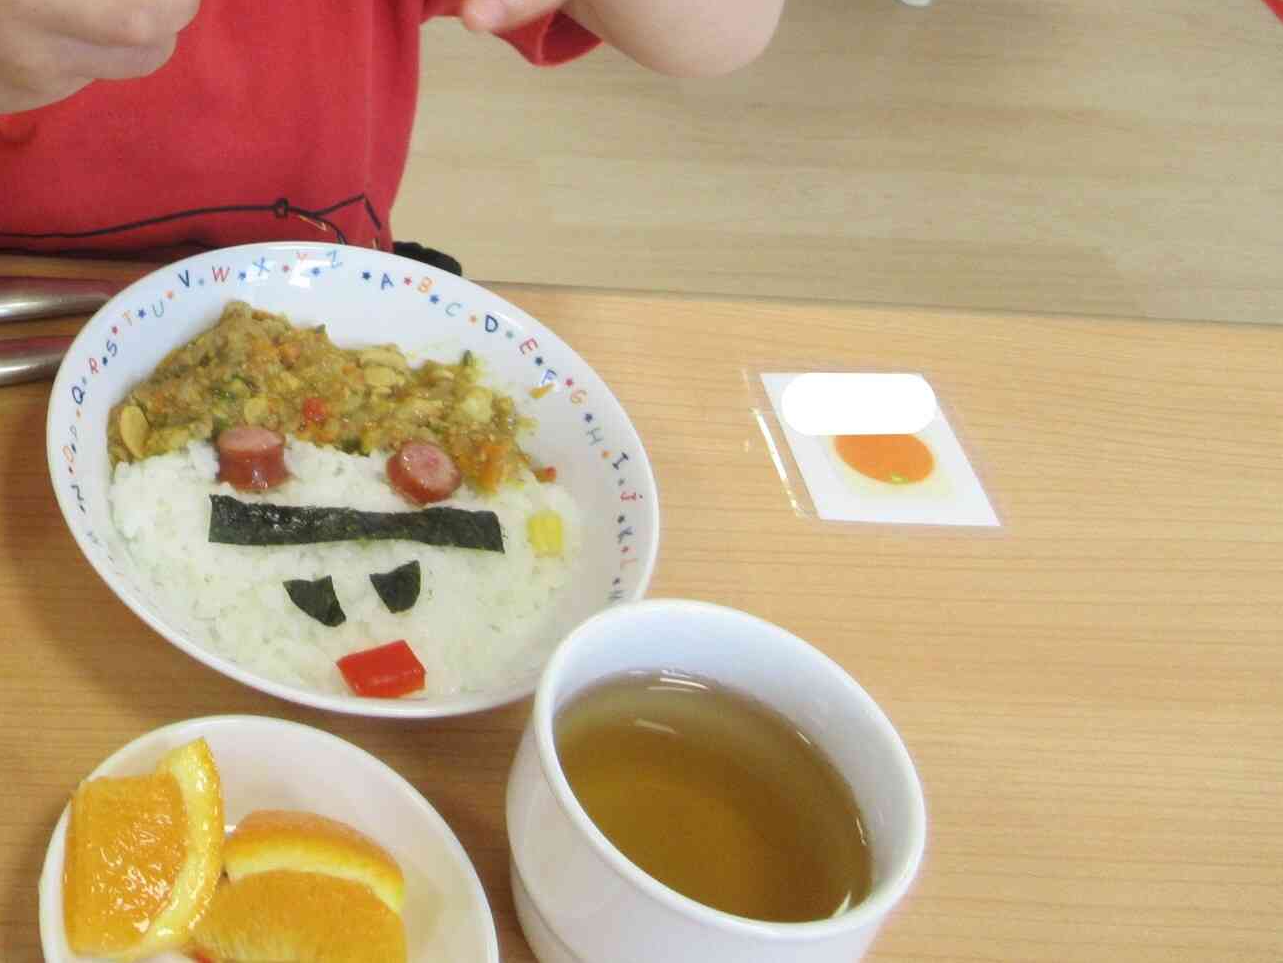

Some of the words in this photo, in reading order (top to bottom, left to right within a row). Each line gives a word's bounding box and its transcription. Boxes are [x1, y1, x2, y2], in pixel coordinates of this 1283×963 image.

[72, 386, 85, 404] Q
[87, 357, 101, 376] R
[107, 341, 118, 358] S
[123, 311, 133, 326] T
[152, 301, 165, 318] U
[178, 270, 191, 289] V
[212, 266, 231, 283] W
[254, 256, 271, 274] X
[327, 250, 343, 269] Z
[380, 272, 394, 290] A
[417, 276, 433, 294] B
[445, 301, 462, 318] C
[484, 314, 499, 333] D
[519, 337, 538, 356] E
[541, 368, 558, 387] F
[570, 389, 588, 406] G
[586, 427, 604, 447] H
[612, 452, 629, 470] I
